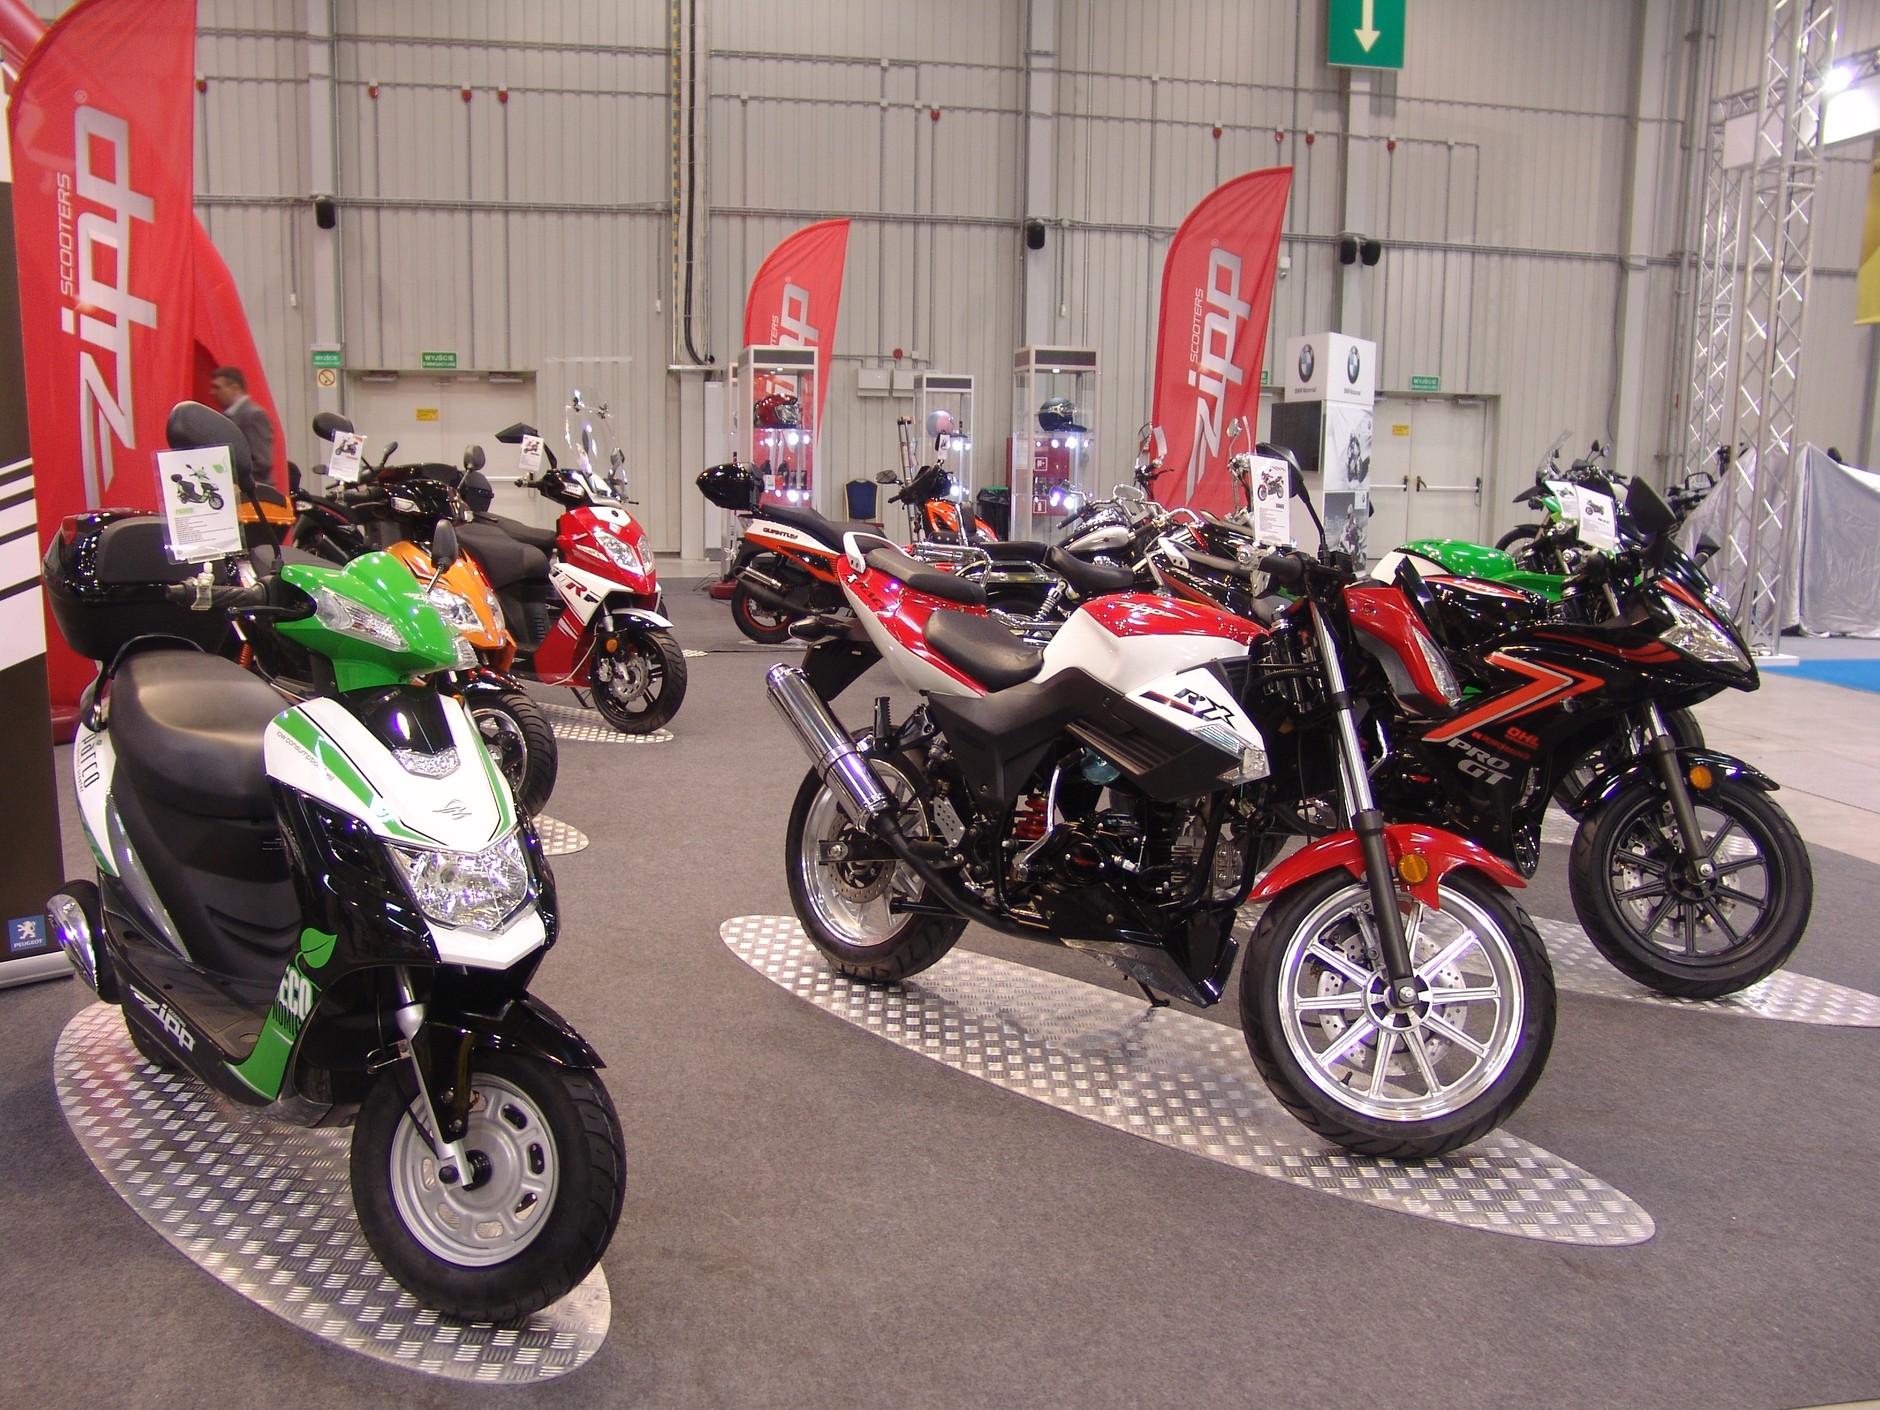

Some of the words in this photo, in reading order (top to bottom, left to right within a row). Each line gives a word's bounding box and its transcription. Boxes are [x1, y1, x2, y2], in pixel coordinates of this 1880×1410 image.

[60, 172, 72, 297] SCOOTERS
[1188, 287, 1204, 364] SCOOTERS
[424, 353, 454, 362] WYJŚCIE
[1447, 737, 1510, 770] PRO
[1457, 759, 1513, 786] GT
[13, 938, 44, 948] PEUGEOT
